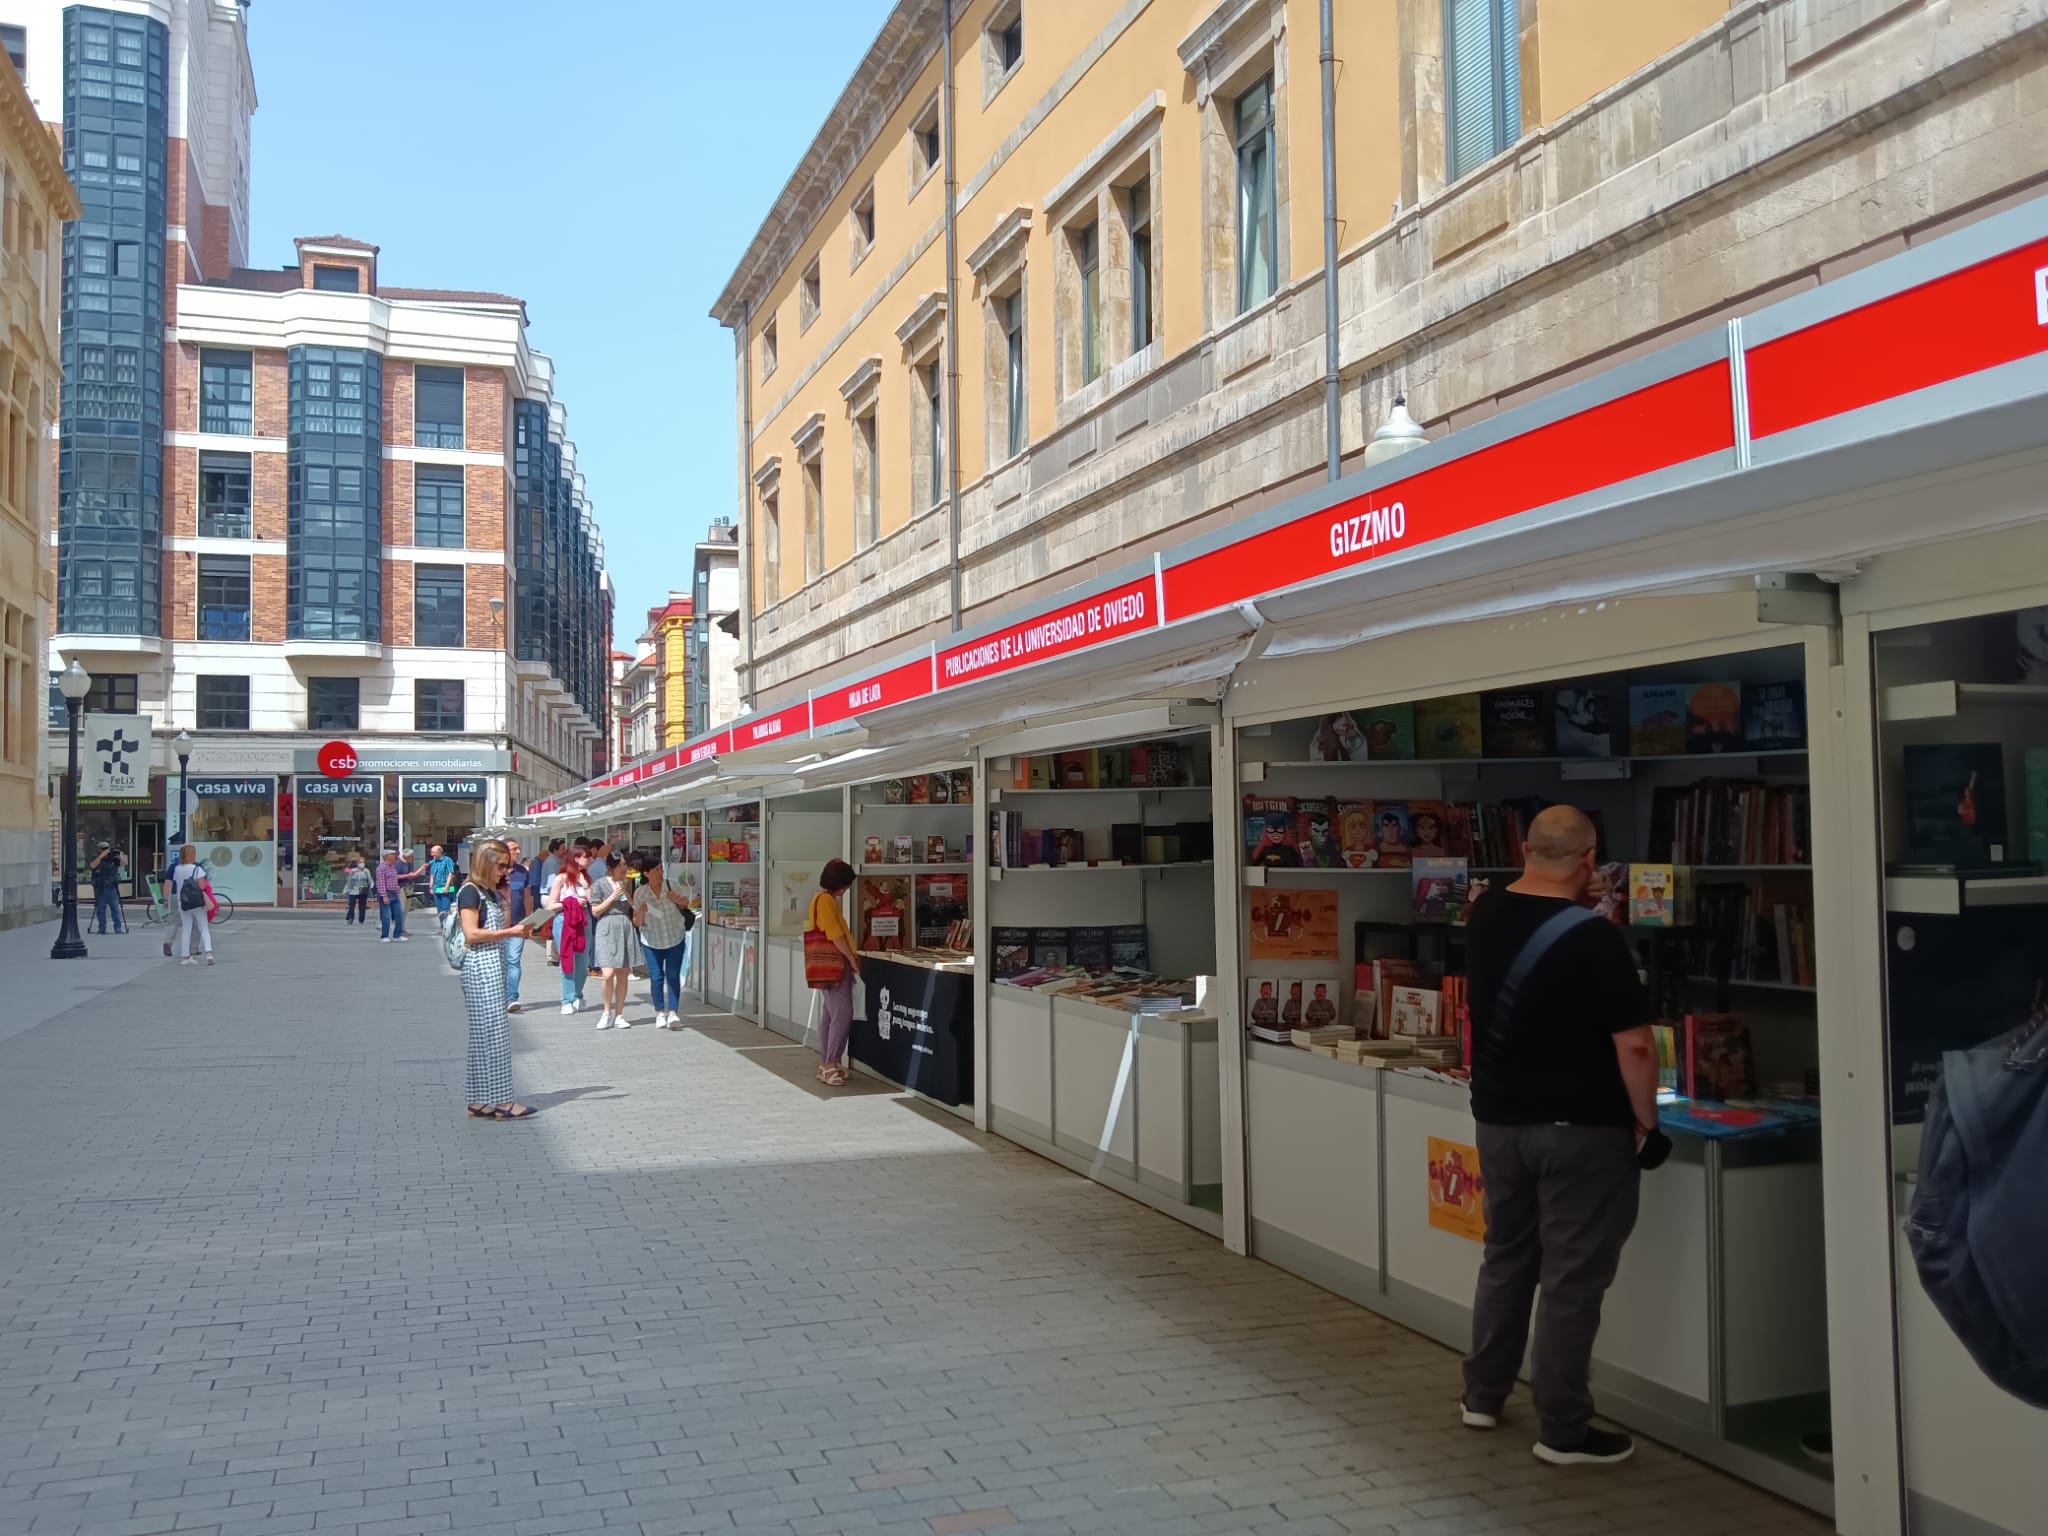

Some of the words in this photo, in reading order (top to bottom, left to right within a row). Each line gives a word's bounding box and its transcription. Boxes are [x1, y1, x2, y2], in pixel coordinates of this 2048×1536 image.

[1330, 501, 1406, 557] GIZZMO
[945, 645, 999, 678] PUBLICACIONES
[1000, 637, 1012, 660] DE
[1012, 635, 1024, 657] LA
[1025, 611, 1085, 652] UNIVERSIDAD
[1087, 606, 1102, 633] DE
[1103, 591, 1145, 628] OVIEDO
[848, 691, 861, 709] HOJA
[329, 755, 357, 769] csb
[358, 759, 419, 769] promociones
[423, 757, 482, 768] inmobiliarias
[196, 782, 231, 794] casa
[234, 780, 266, 794] viva
[305, 782, 339, 794] casa
[342, 779, 373, 794] viva
[411, 781, 444, 793] casa
[447, 779, 477, 793] viva
